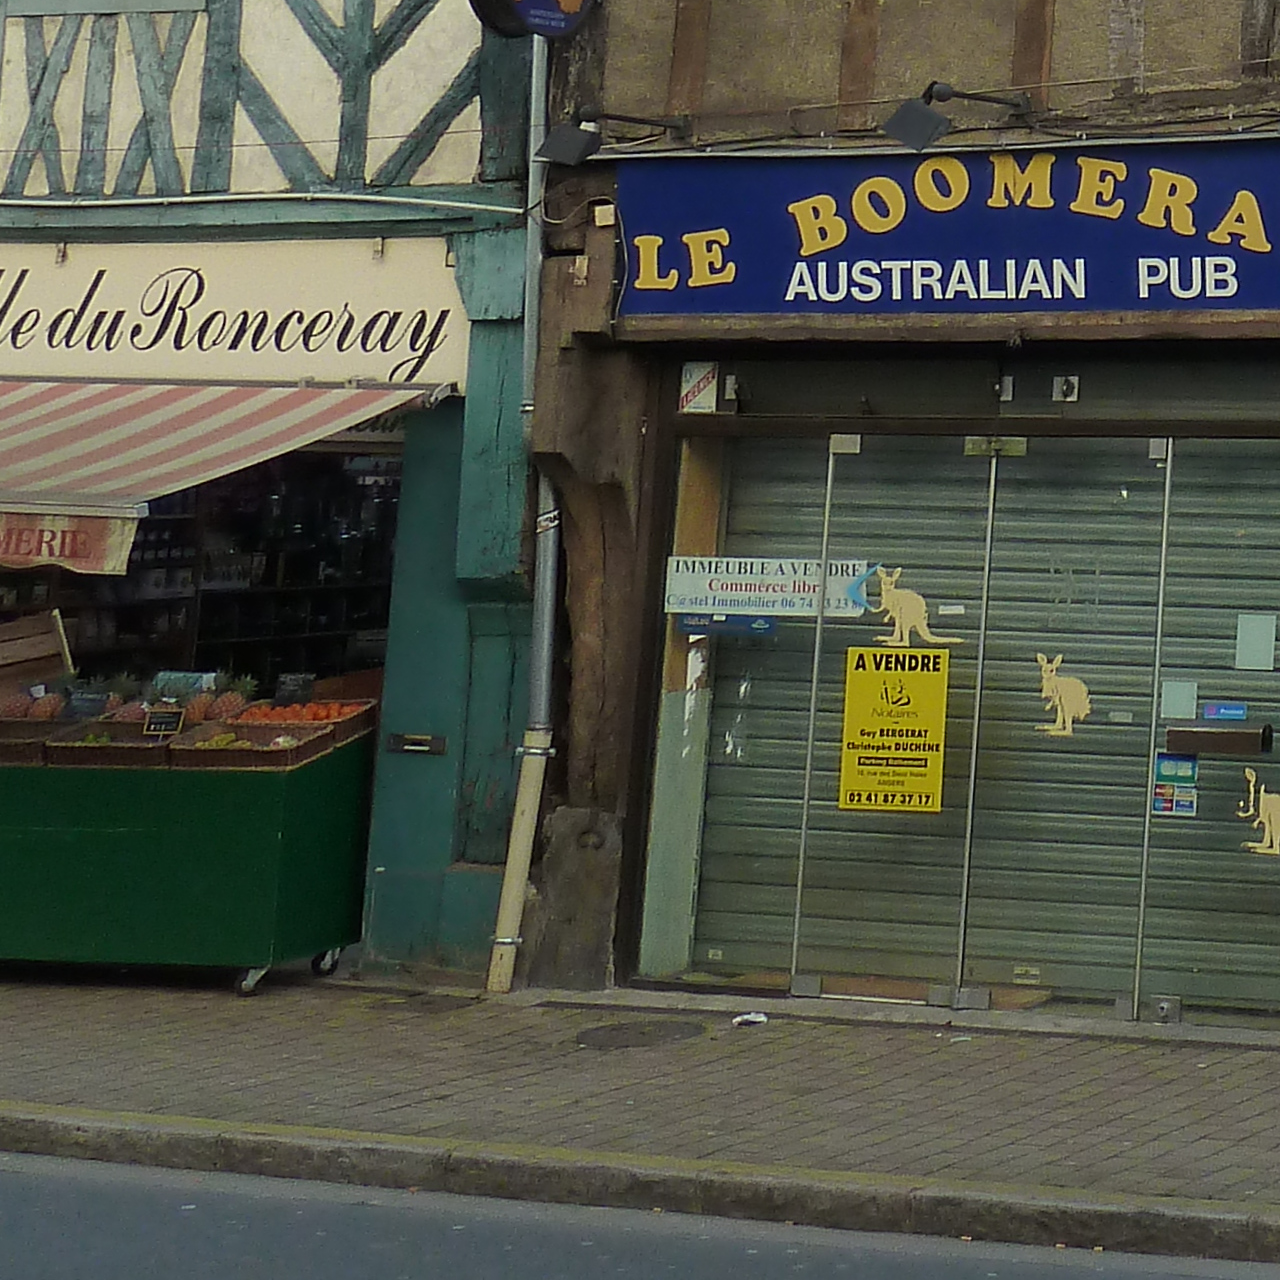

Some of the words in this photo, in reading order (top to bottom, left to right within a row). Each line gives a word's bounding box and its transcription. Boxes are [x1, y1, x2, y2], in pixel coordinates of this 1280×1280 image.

[633, 227, 737, 291] LE
[783, 257, 1087, 302] AUSTRALIAN
[1137, 256, 1239, 300] PUB
[0, 268, 37, 350] le
[46, 268, 127, 352] du
[129, 266, 451, 382] Ronceray
[675, 559, 769, 576] IMMEUBLE
[776, 561, 786, 576] A
[791, 579, 827, 594] libr
[712, 594, 778, 609] Immobilier
[780, 597, 795, 608] 06
[800, 597, 813, 608] 74
[854, 653, 866, 671] A
[872, 653, 941, 672] VENDRE
[871, 707, 918, 718] Notaires
[860, 728, 877, 739] Guy
[879, 728, 929, 738] BERGERAT
[847, 742, 892, 752] Christophe
[849, 792, 862, 802] 02
[866, 792, 878, 803] 41
[883, 793, 896, 803] 87
[900, 794, 914, 804] 37
[918, 795, 931, 805] 17
